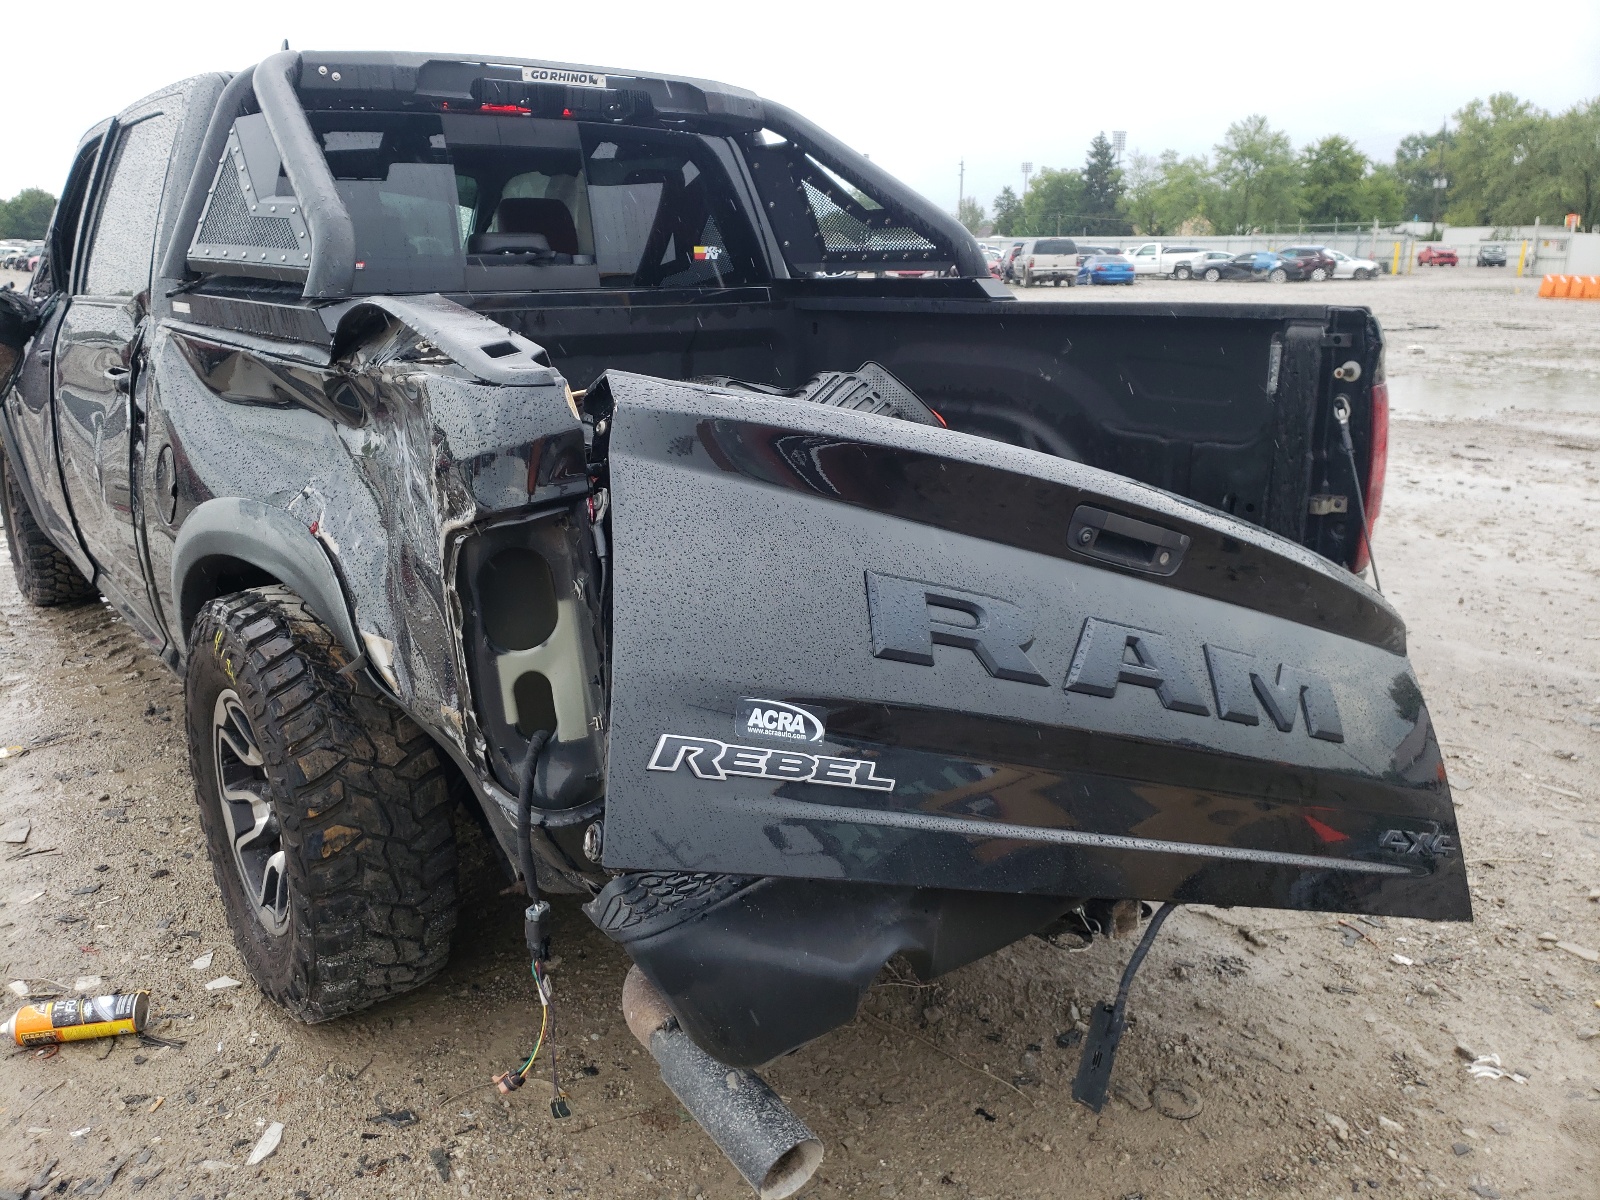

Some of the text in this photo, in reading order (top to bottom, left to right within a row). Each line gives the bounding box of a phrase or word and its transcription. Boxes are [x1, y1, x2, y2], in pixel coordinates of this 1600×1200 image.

[864, 568, 1345, 744] RAM
[747, 707, 806, 734] ACRA
[747, 726, 807, 740] www.acraauto.com
[646, 733, 896, 792] REBEL
